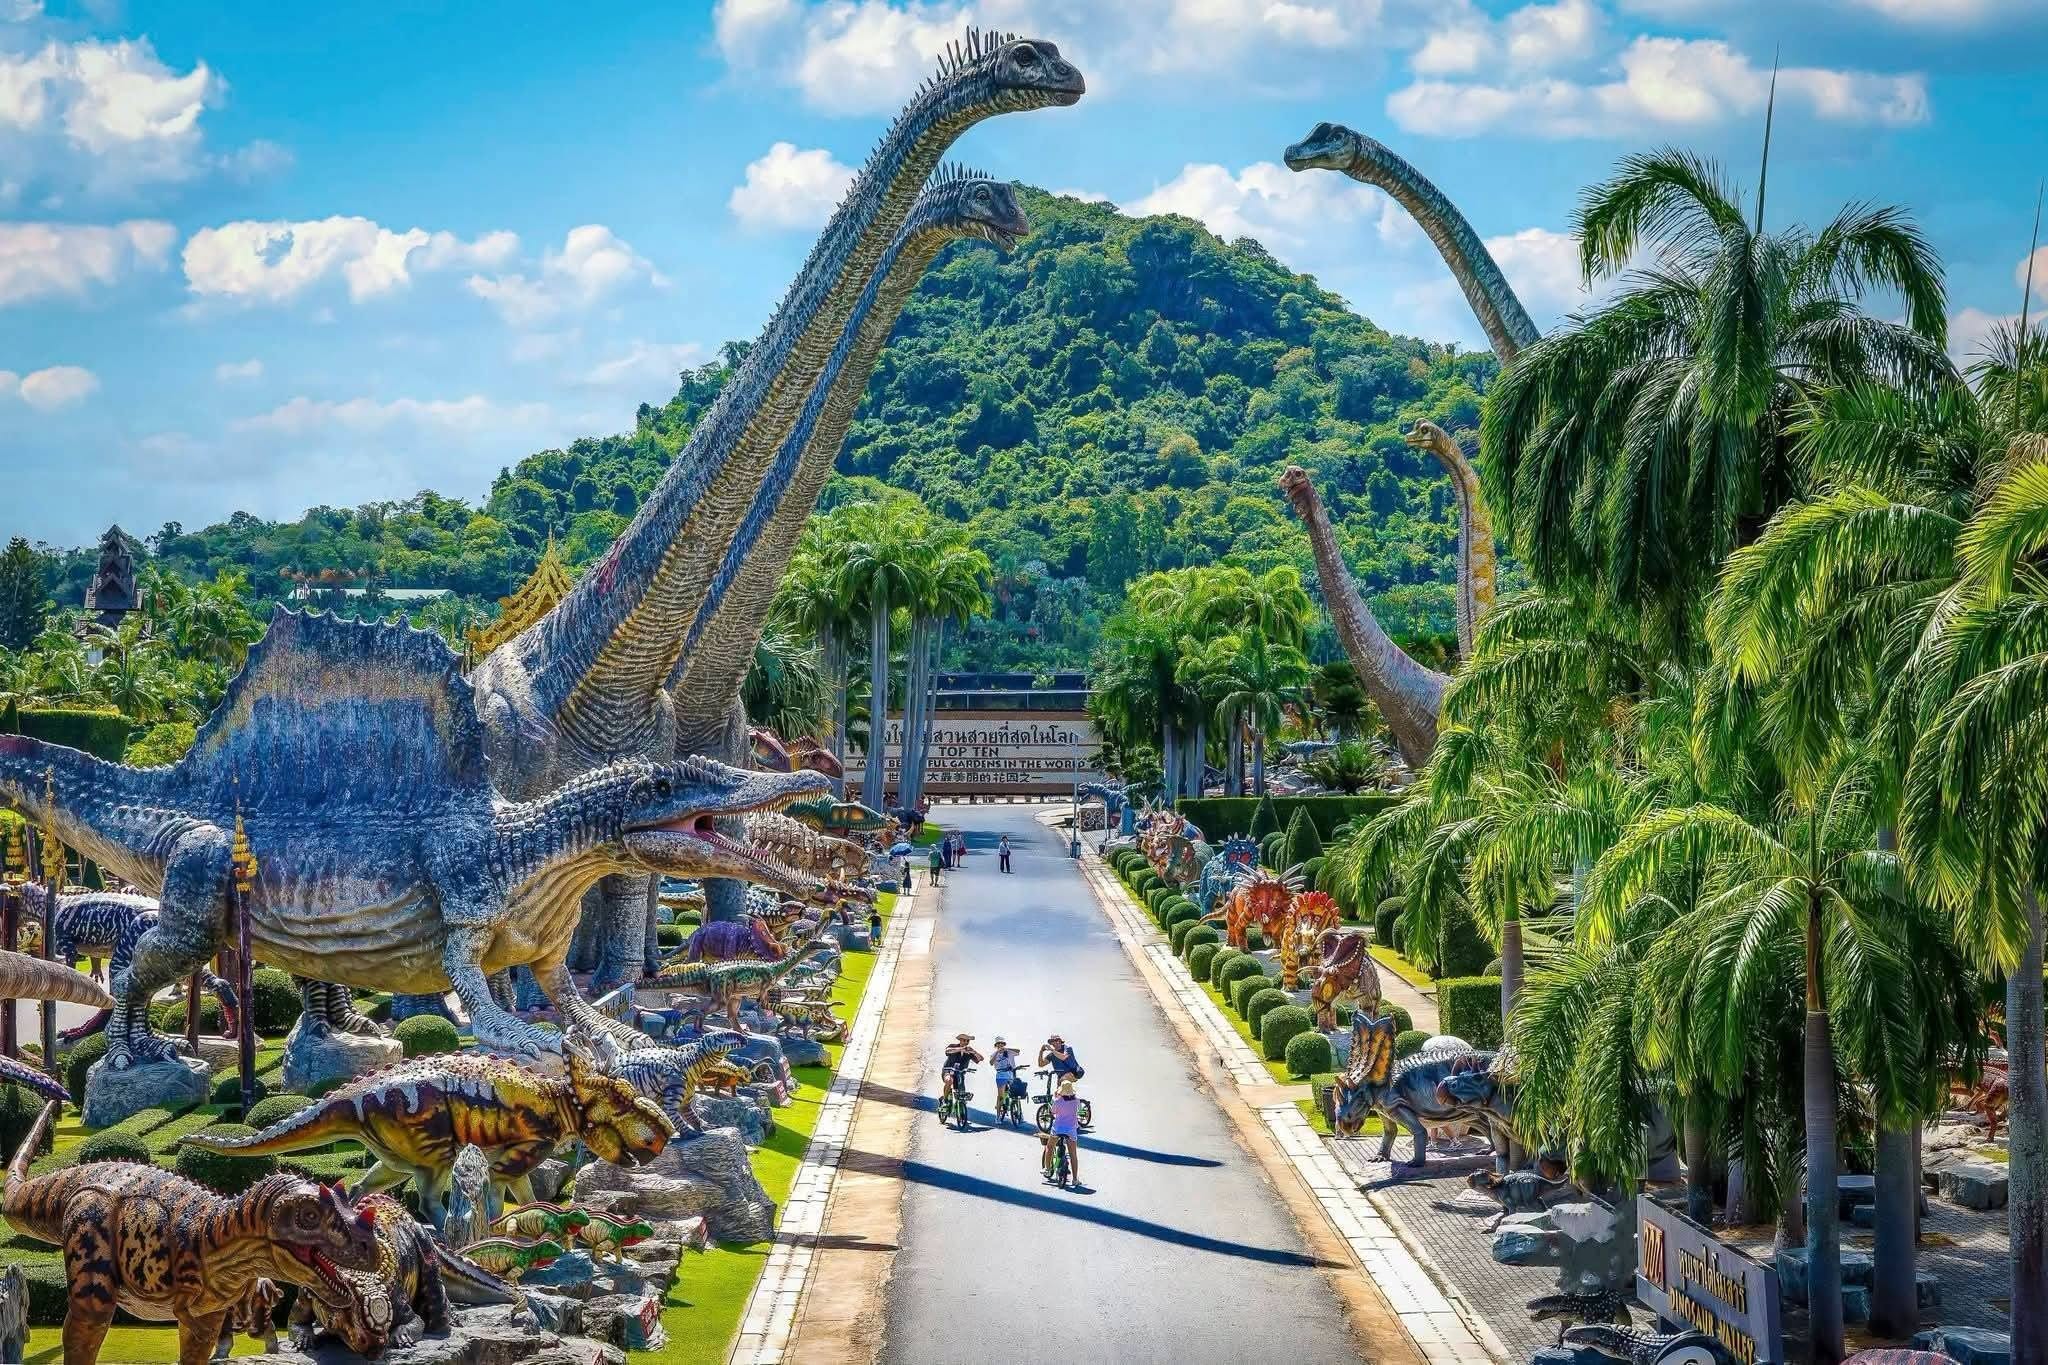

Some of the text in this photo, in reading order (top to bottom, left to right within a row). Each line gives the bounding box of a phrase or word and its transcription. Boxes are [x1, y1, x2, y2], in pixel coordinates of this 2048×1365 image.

[939, 747, 998, 757] TOP TEN
[950, 760, 1001, 768] GARDENS
[1004, 760, 1017, 768] IN
[1021, 760, 1041, 768] THE
[1670, 1286, 1755, 1365] DINOSAUR VALLEY
